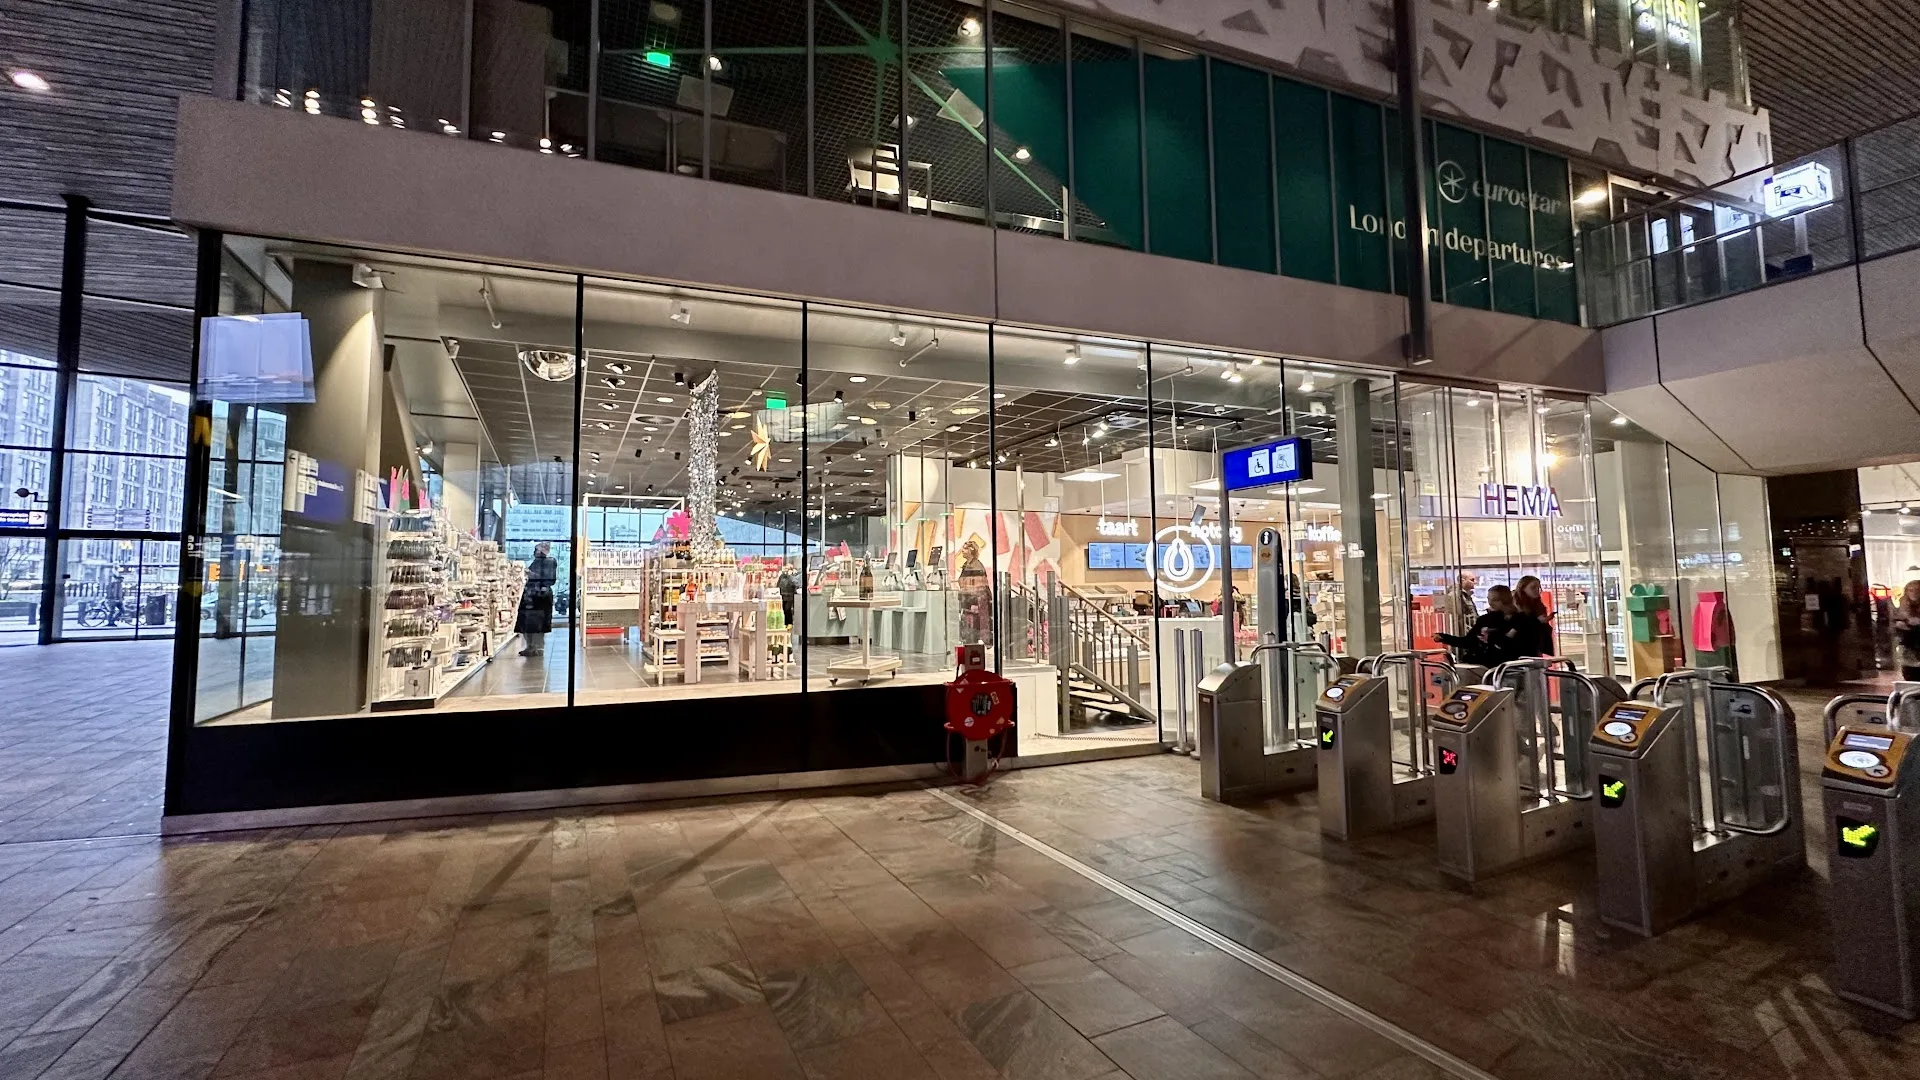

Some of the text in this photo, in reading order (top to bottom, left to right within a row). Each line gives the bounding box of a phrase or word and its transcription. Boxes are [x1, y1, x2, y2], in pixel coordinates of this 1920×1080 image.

[1473, 179, 1561, 214] eurostar
[1350, 204, 1568, 272] Londn departures
[1479, 483, 1564, 518] HEMA
